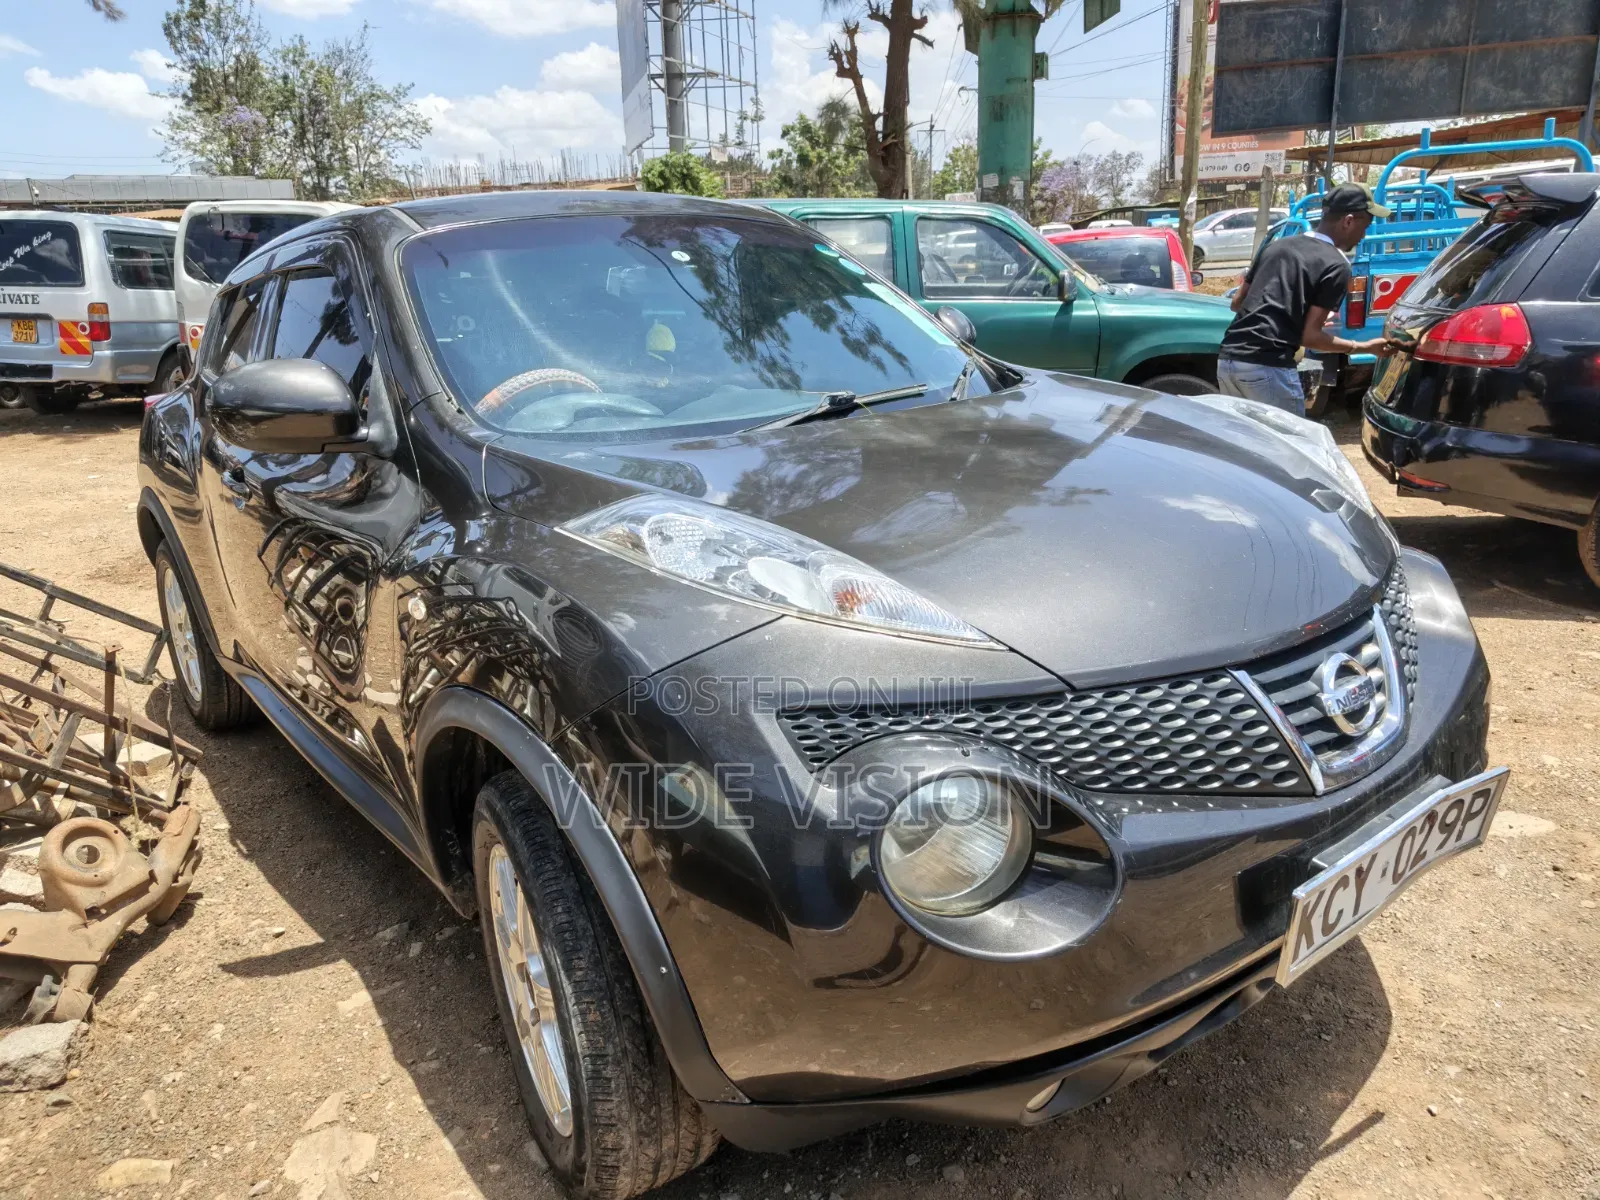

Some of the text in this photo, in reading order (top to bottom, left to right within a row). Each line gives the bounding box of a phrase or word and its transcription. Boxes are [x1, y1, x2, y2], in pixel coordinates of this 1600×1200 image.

[1227, 141, 1259, 149] COUNTIES
[0, 293, 40, 305] IVATE
[14, 331, 34, 342] 371V
[1335, 683, 1374, 710] NISS
[1293, 787, 1492, 960] KCY 029P
